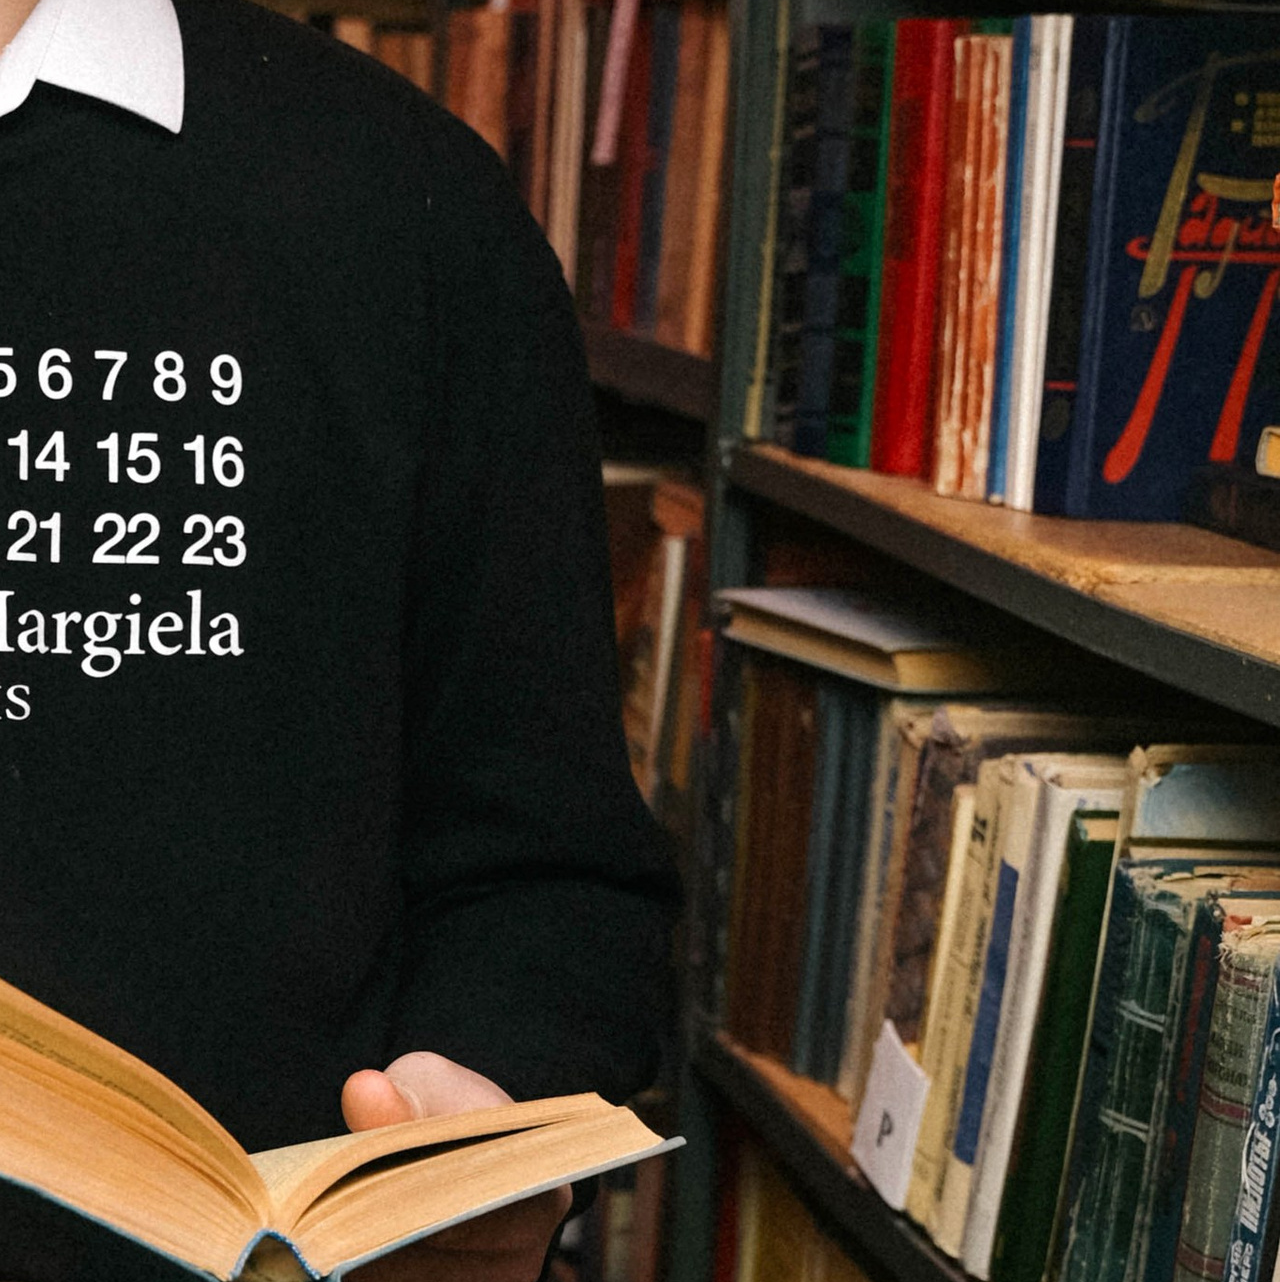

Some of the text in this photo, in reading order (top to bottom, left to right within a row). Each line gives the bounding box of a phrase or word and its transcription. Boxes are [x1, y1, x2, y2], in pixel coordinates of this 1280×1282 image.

[38, 348, 72, 399] 6
[95, 350, 127, 400] 7
[153, 351, 186, 401] 8
[210, 354, 242, 405] 9
[8, 430, 70, 481] 14
[97, 432, 161, 483] 15
[184, 435, 244, 487] 16
[7, 510, 60, 563] 21
[92, 513, 160, 564] 22
[182, 514, 246, 567] 23
